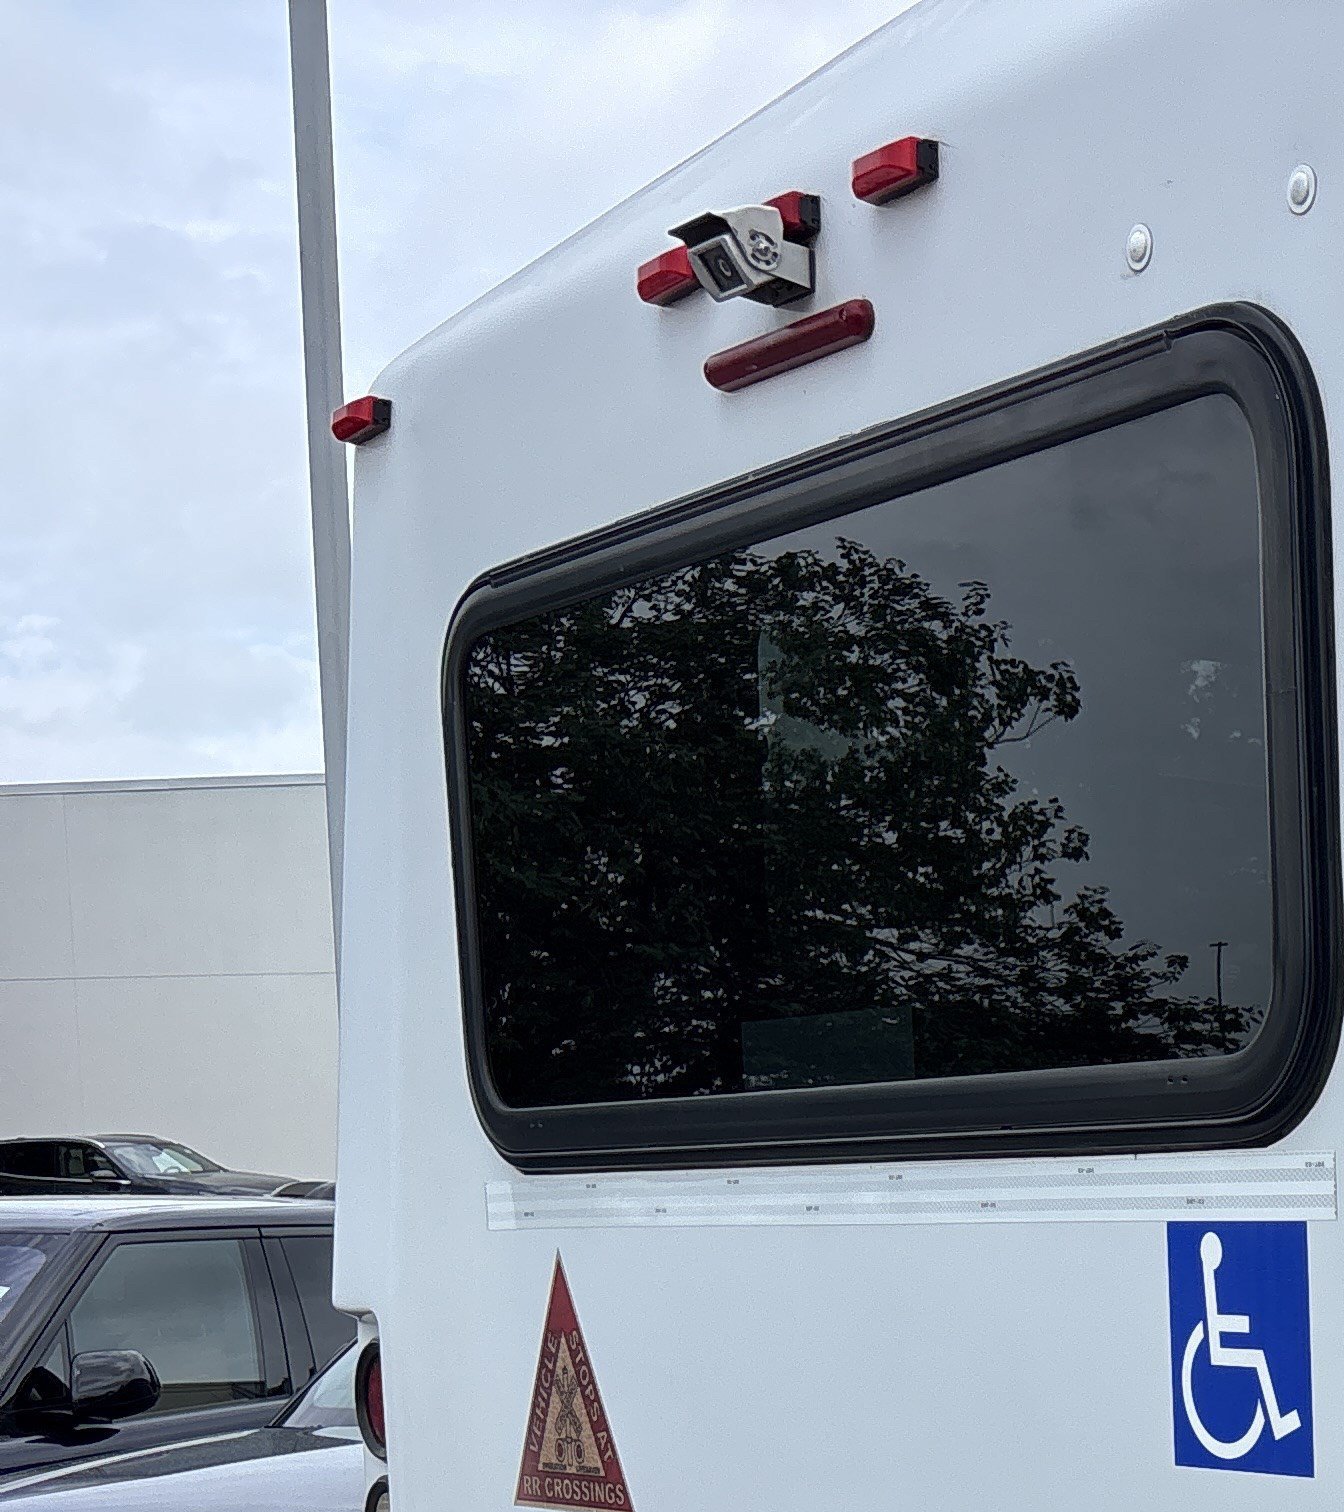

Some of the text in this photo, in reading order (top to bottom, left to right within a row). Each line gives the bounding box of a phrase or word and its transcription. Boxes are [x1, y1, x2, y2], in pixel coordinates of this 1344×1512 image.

[529, 1332, 558, 1453] VEHICLE
[568, 1330, 614, 1462] STOPS AT
[523, 1475, 625, 1505] RR CROSSINGS
